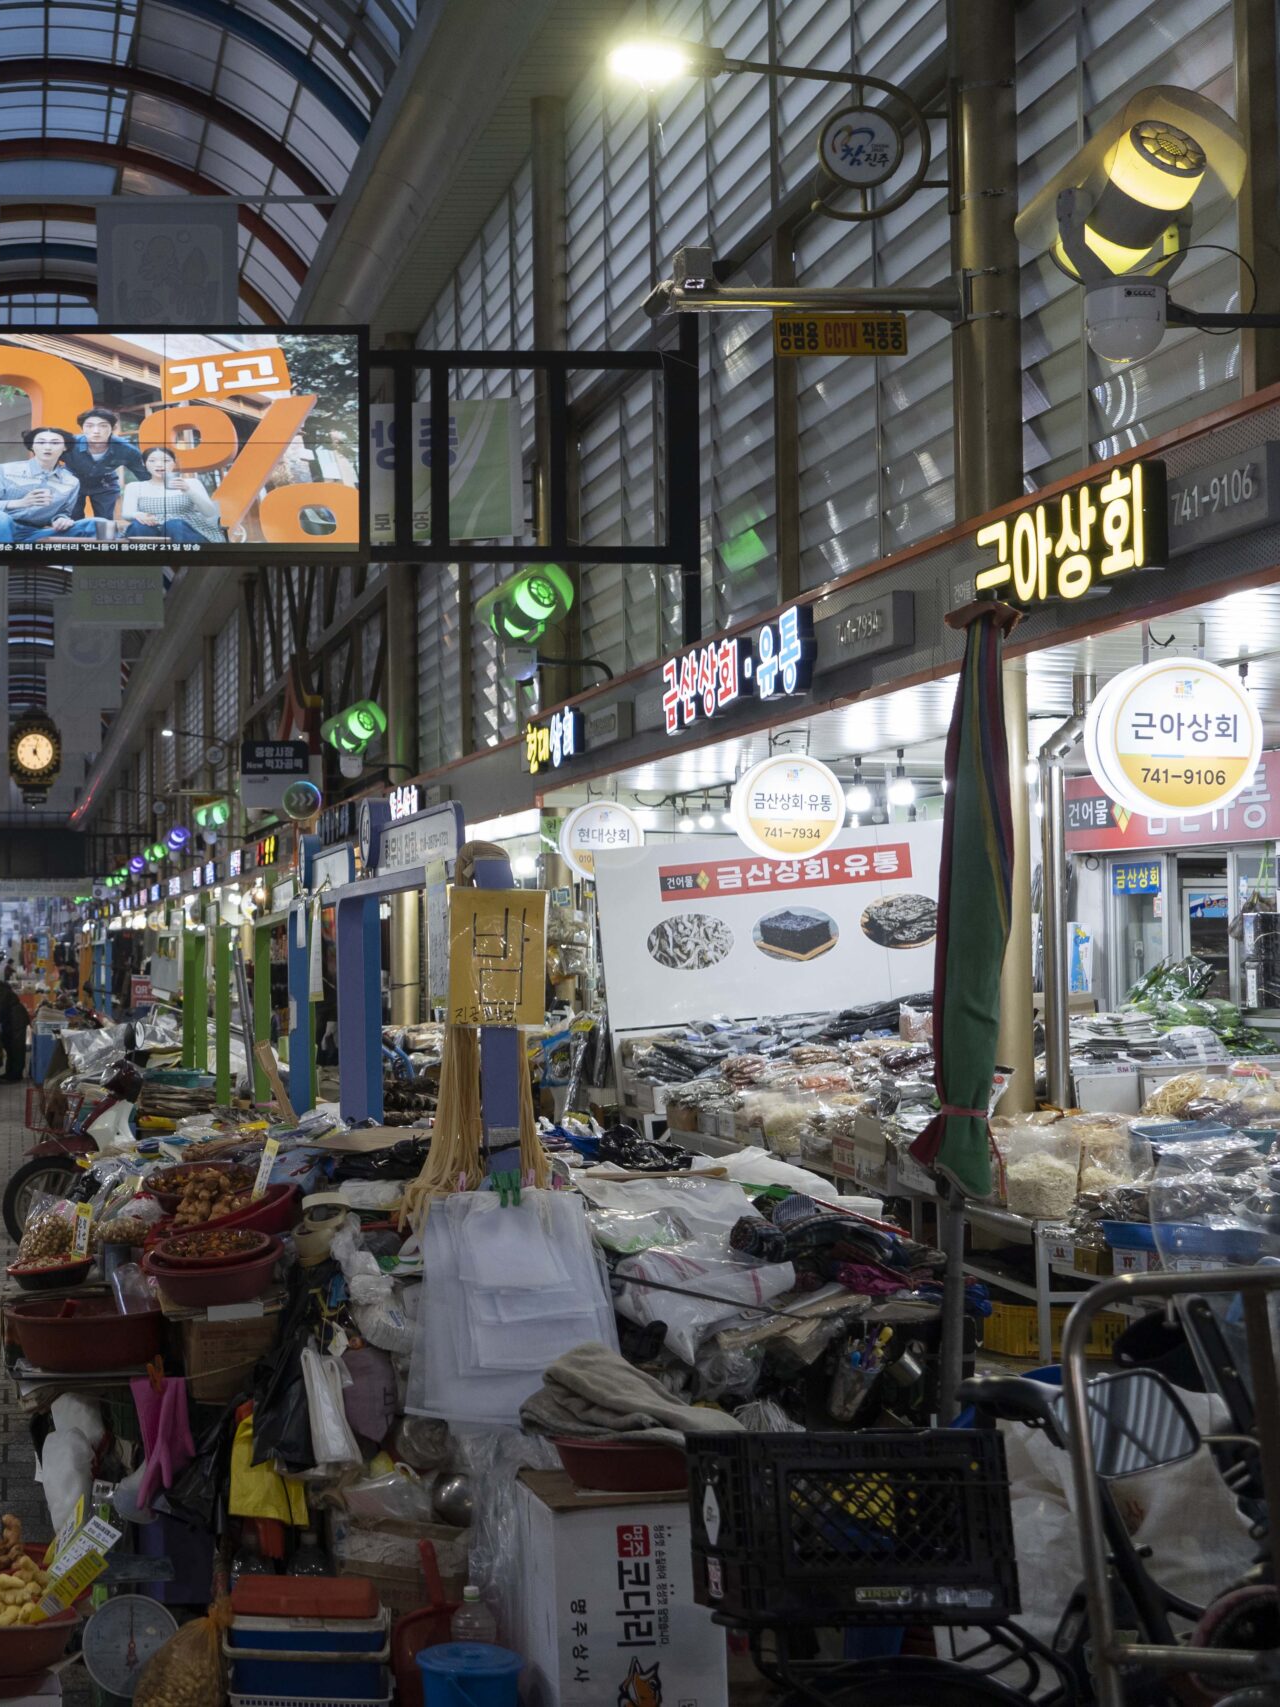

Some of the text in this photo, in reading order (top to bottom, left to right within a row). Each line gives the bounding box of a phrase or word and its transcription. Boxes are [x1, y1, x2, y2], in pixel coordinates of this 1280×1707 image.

[778, 322, 904, 350] 방범용 CCTV 작동중
[169, 354, 275, 396] 가고
[1171, 463, 1256, 526] 741-9106
[35, 543, 79, 552] 다큐멘터리
[160, 543, 180, 552] 21일
[183, 543, 201, 552] 방송
[835, 609, 881, 646] 741-7934
[526, 705, 574, 774] 현대상회
[1131, 712, 1238, 743] 근아상회
[1141, 768, 1226, 786] 741-9106
[1068, 800, 1109, 828] 건어물
[577, 827, 630, 844] 현대상회
[763, 826, 821, 840] 741-7934
[666, 874, 694, 890] 건어물
[1116, 867, 1160, 889] 금산상회
[616, 1525, 657, 1647] 명주 코다리
